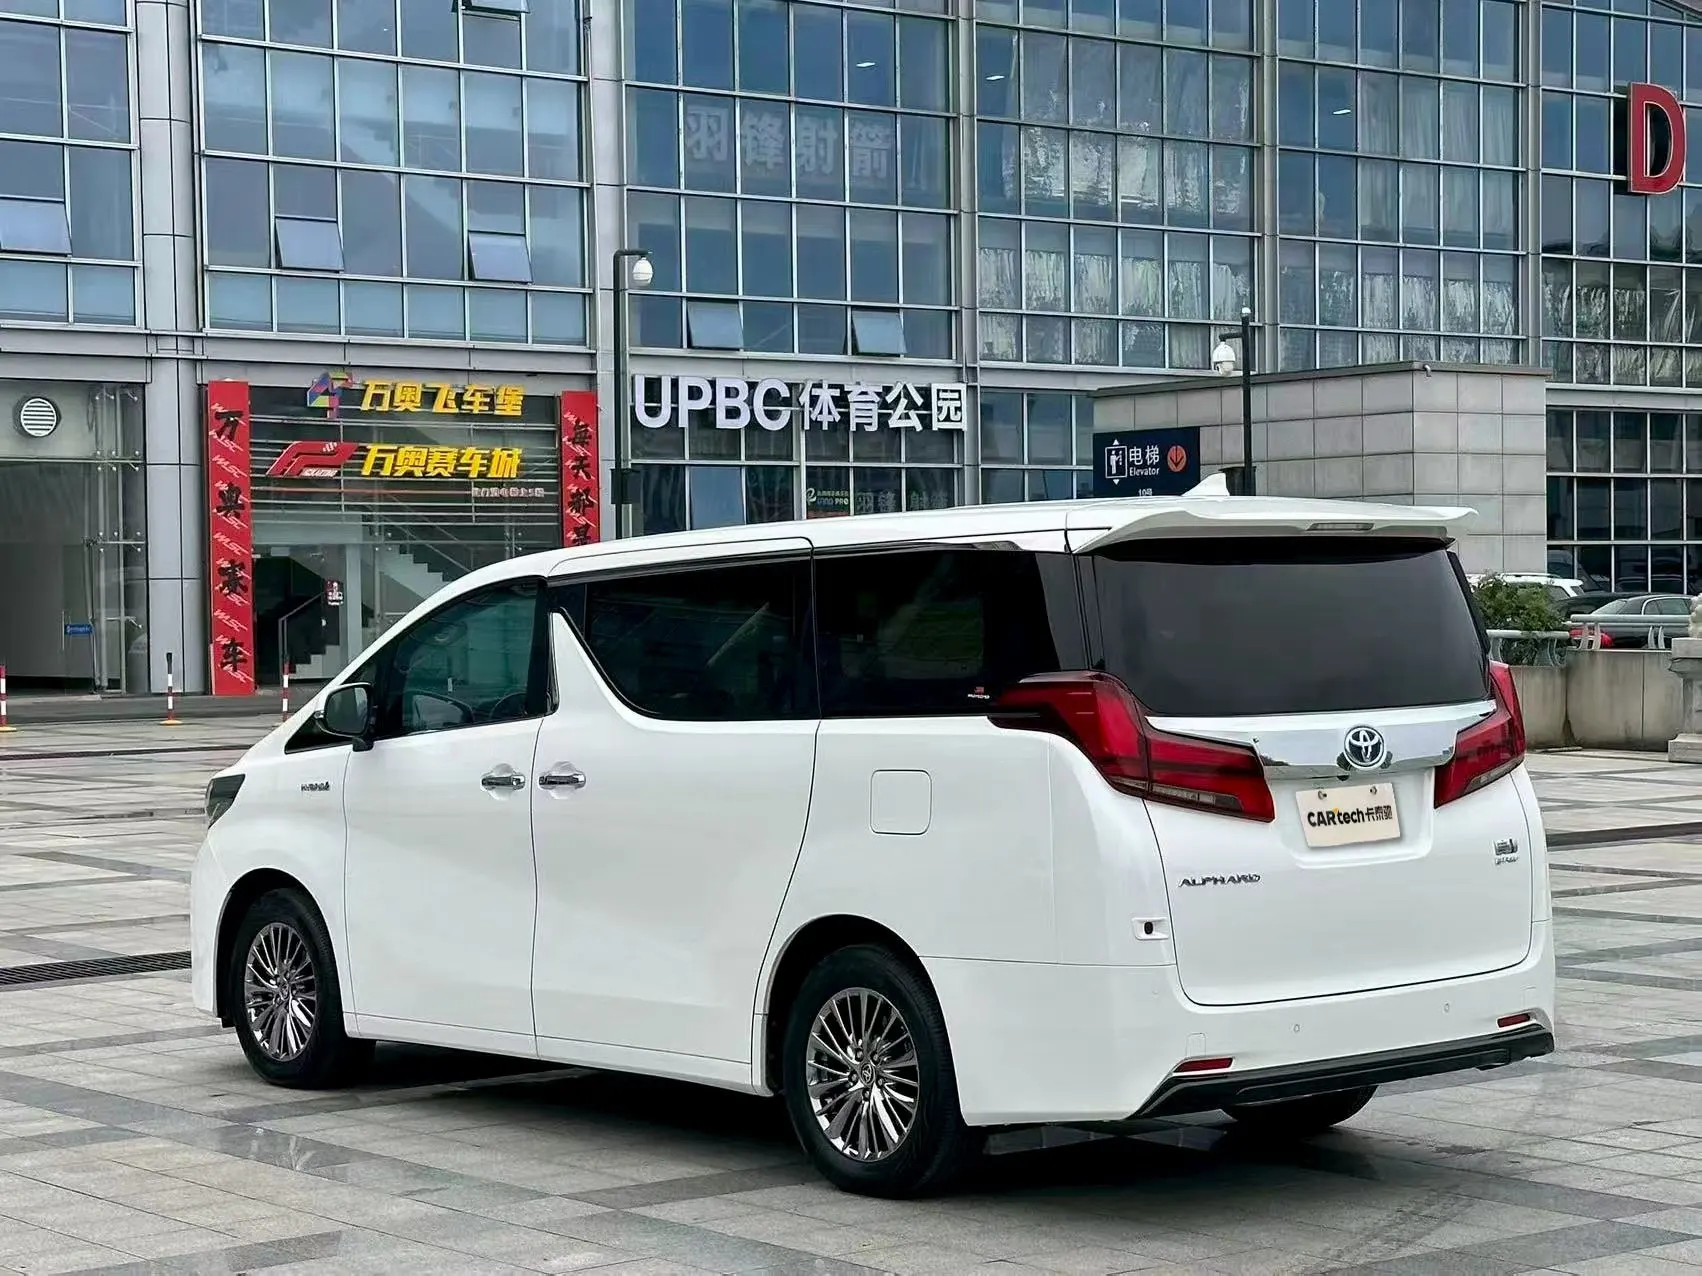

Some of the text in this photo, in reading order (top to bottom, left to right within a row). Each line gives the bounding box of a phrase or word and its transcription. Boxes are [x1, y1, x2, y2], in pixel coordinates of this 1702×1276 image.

[1627, 82, 1687, 194] D
[360, 380, 524, 416] 万奥飞车堡
[634, 375, 967, 432] UPBC 体育公园
[361, 443, 522, 478] 万奥赛车城
[1129, 445, 1160, 466] 电梯
[1129, 467, 1160, 477] Elevator
[1307, 808, 1365, 828] CARtech
[1178, 874, 1260, 887] ALPHARD
